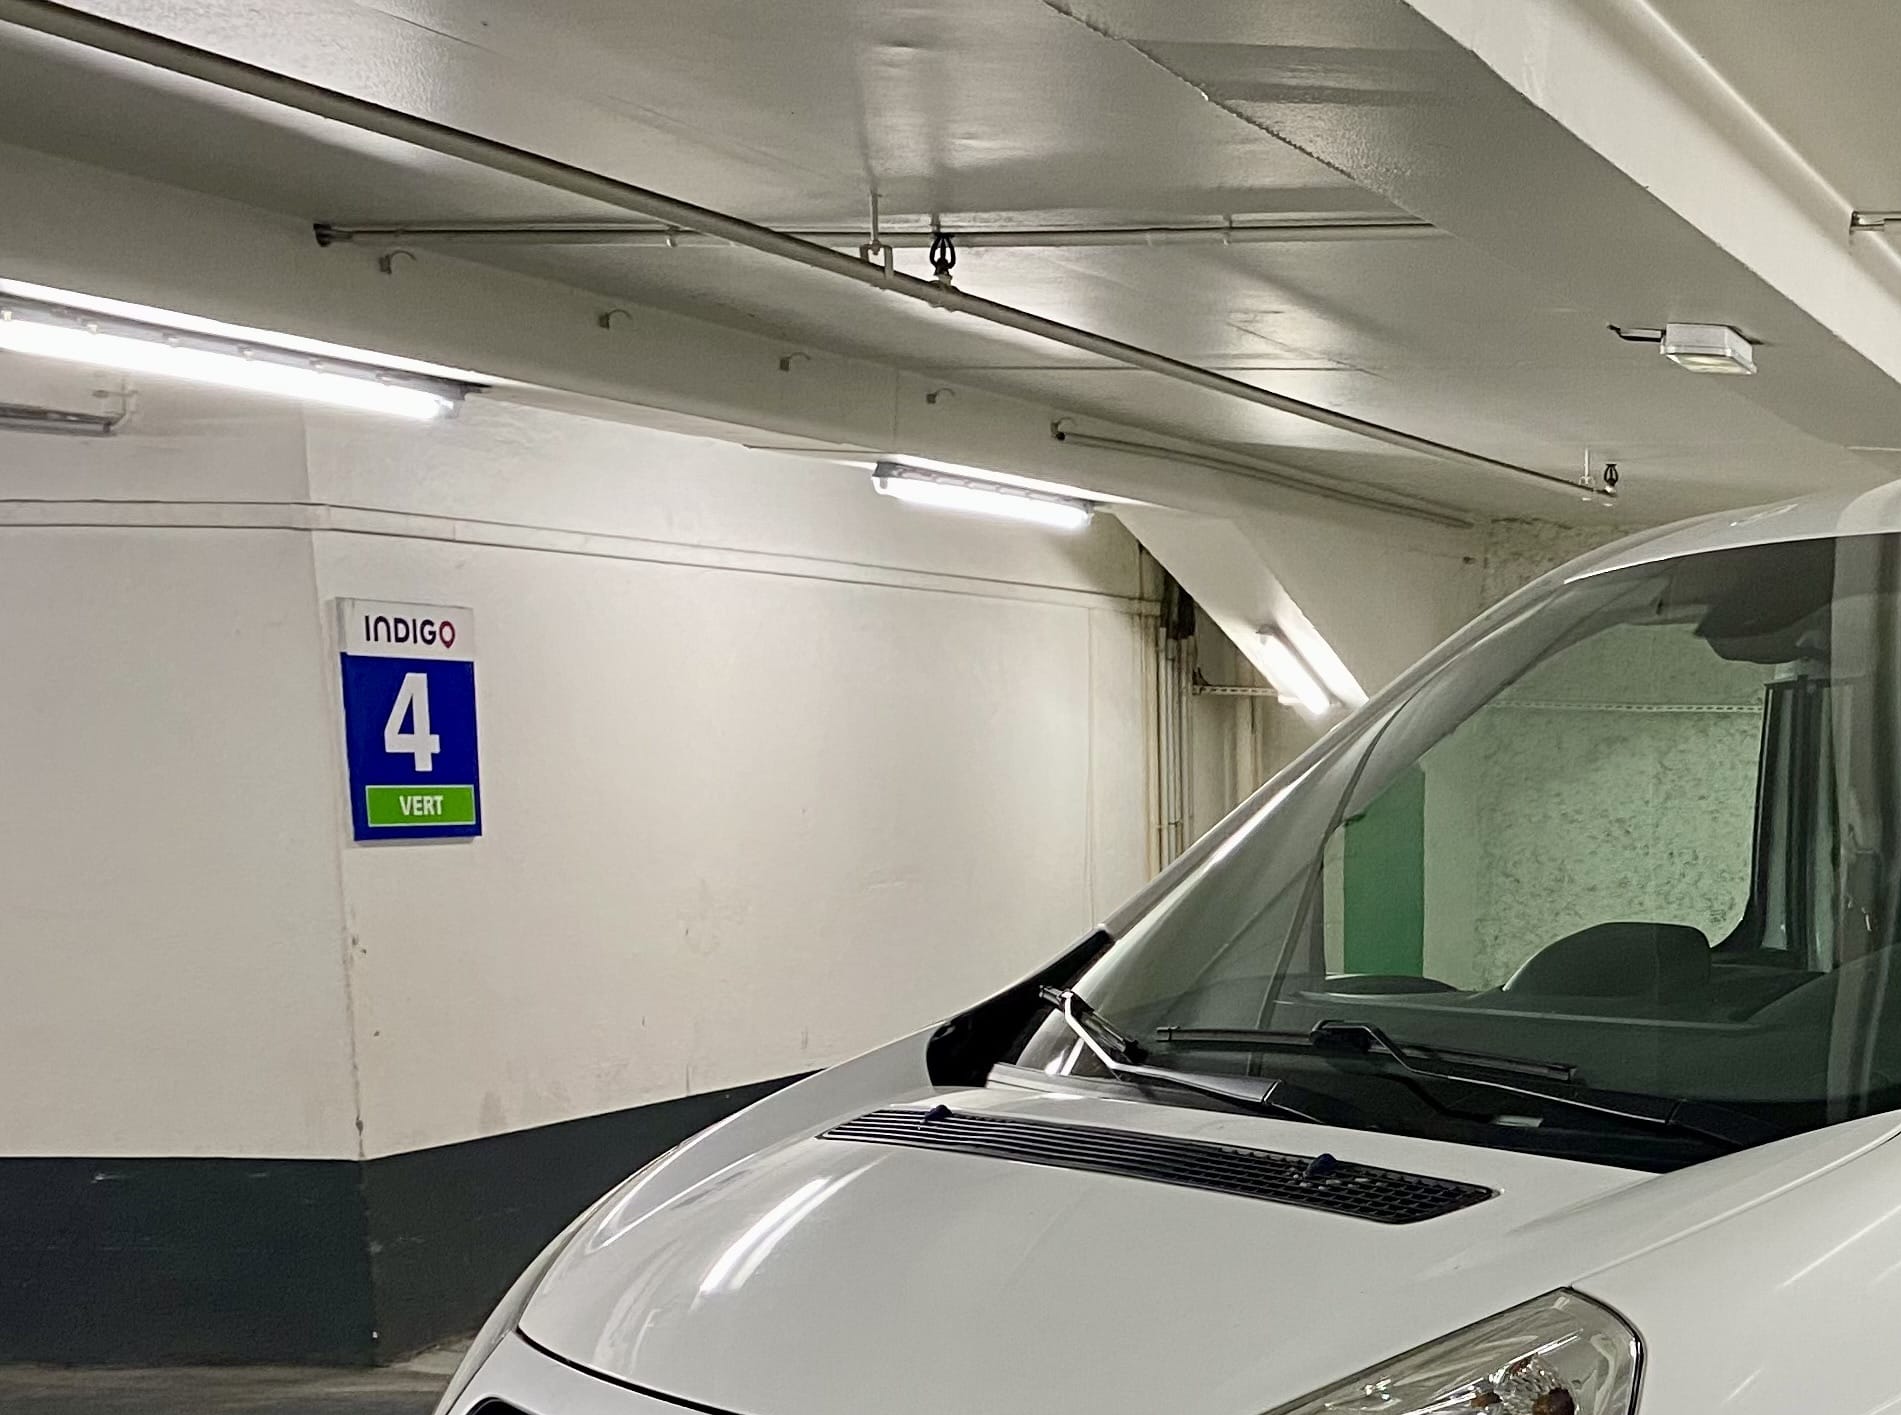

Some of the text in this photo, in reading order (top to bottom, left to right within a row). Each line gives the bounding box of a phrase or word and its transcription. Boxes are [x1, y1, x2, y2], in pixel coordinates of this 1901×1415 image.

[364, 615, 456, 649] INDIGO
[383, 672, 441, 772] 4
[399, 795, 444, 816] VERT
